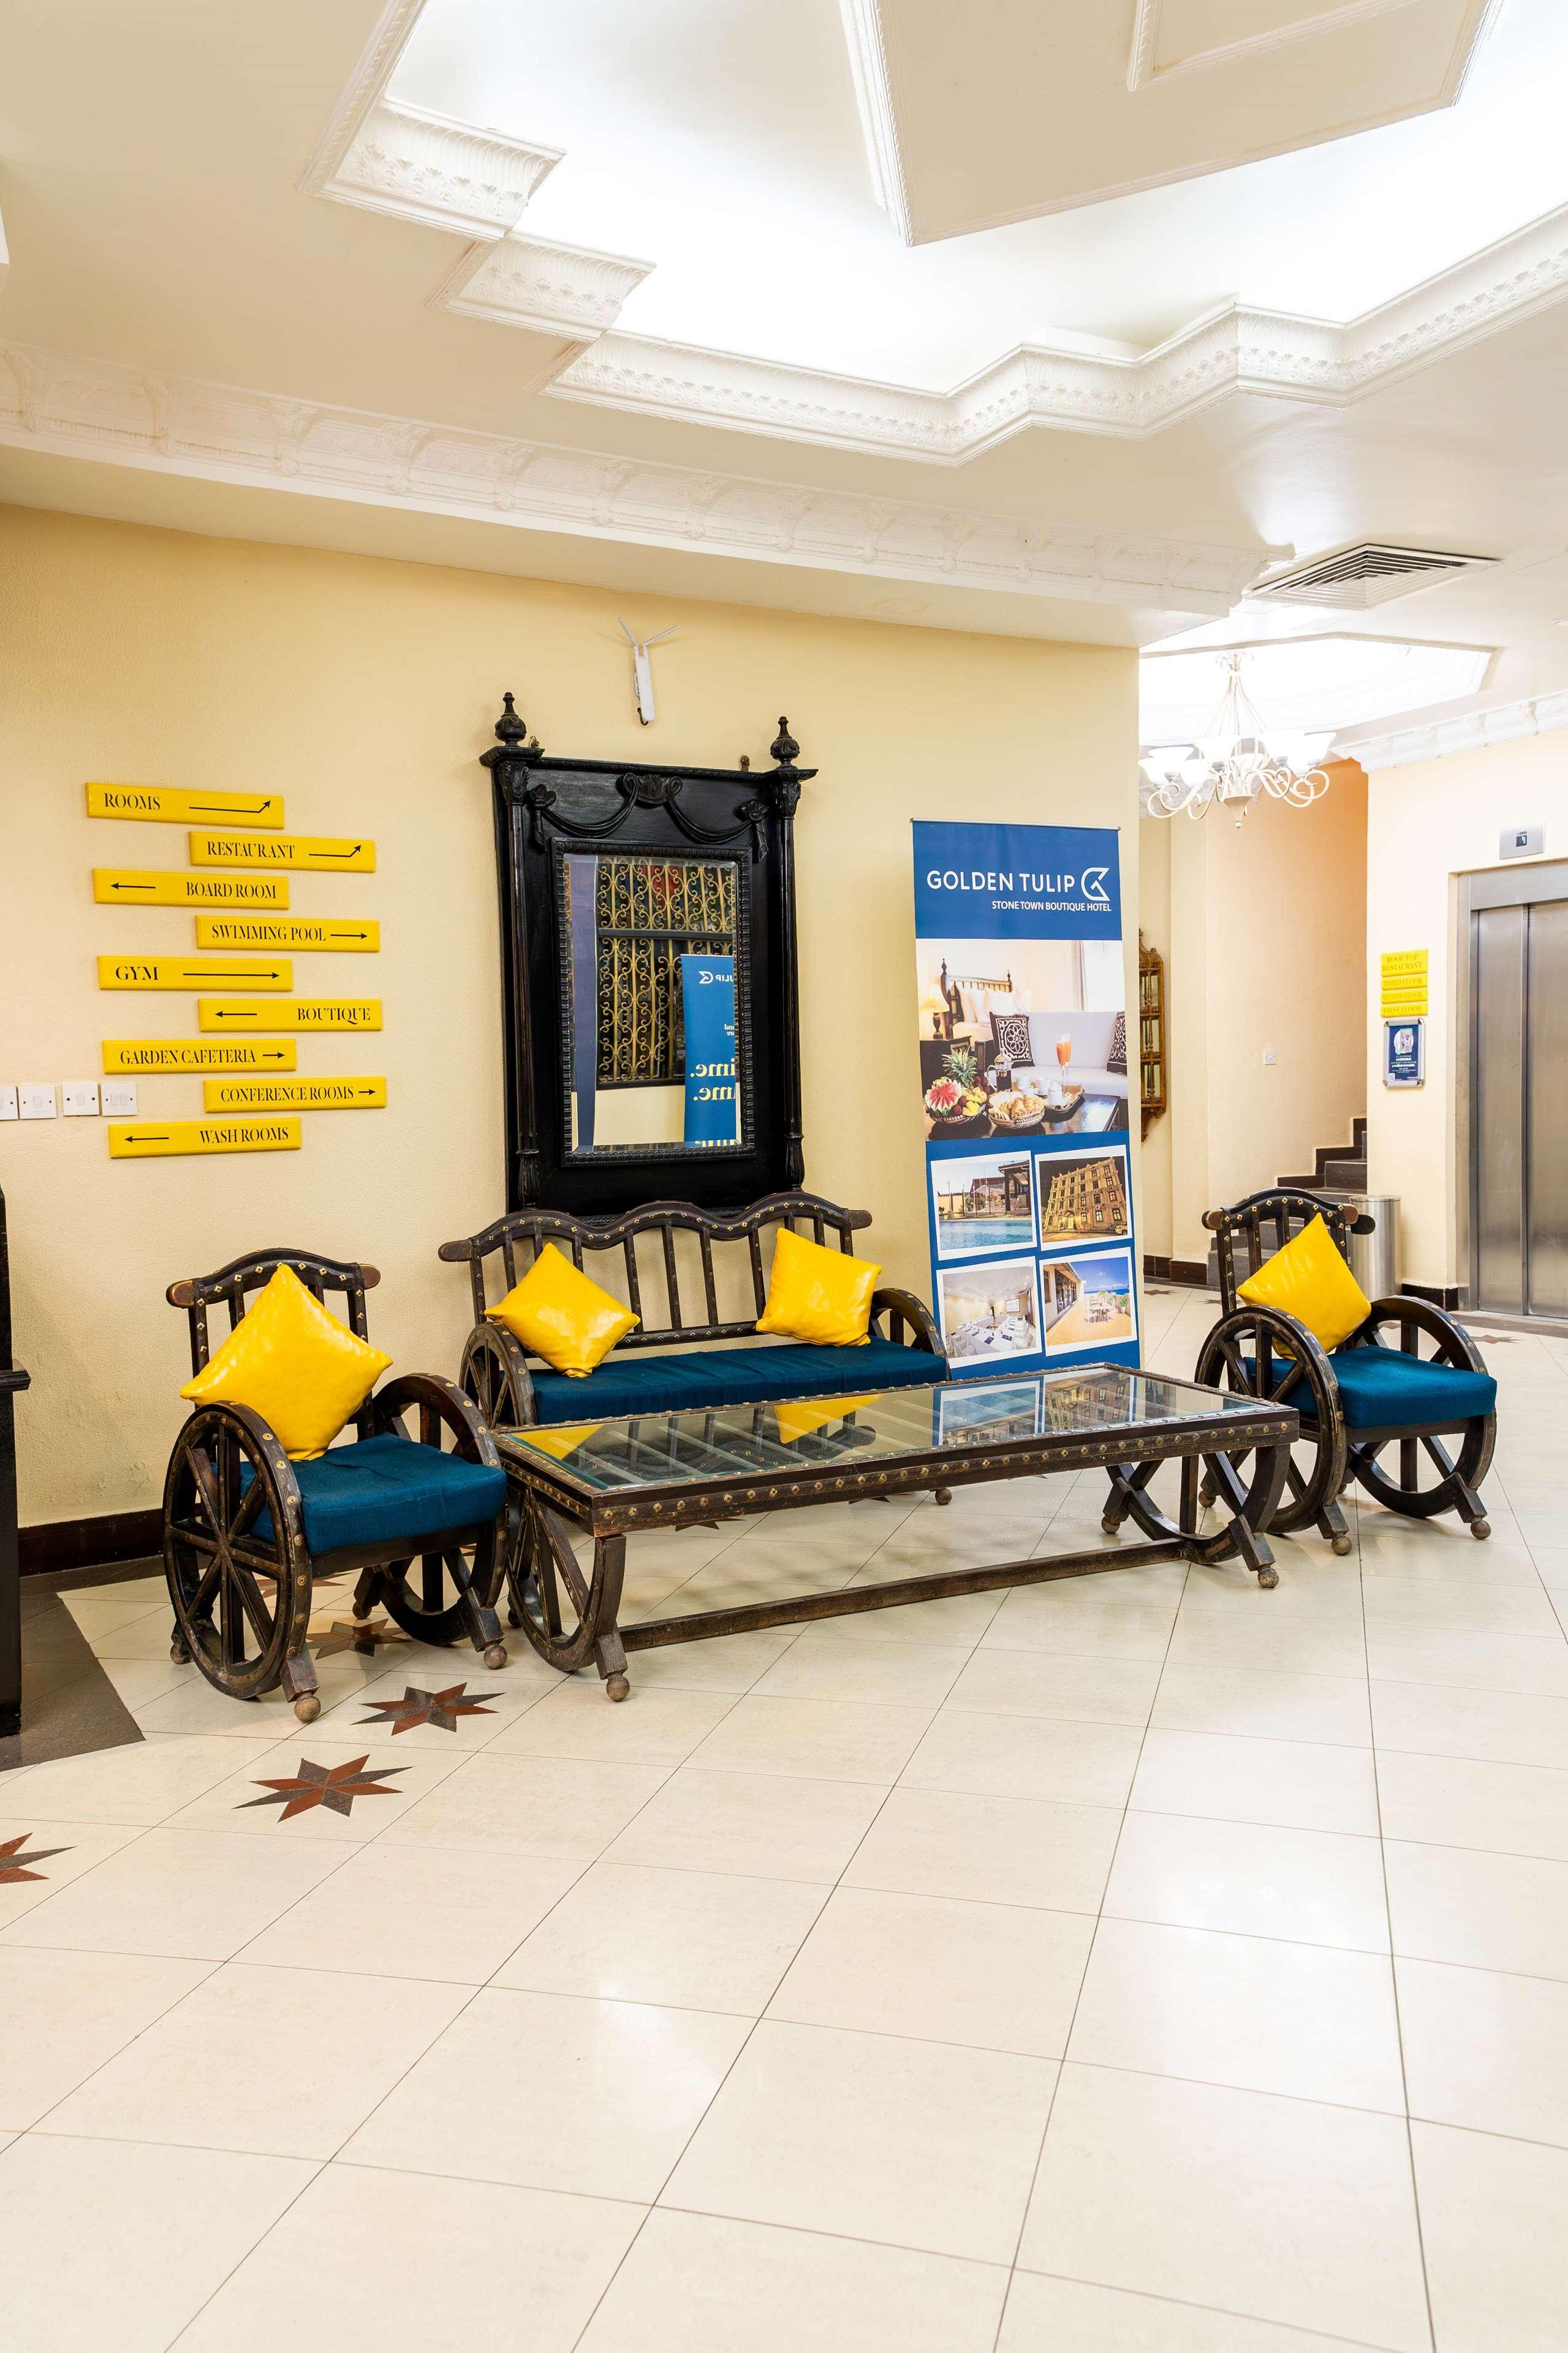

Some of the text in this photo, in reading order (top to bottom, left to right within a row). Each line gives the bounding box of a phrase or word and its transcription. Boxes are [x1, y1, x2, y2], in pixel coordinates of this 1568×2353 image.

[104, 793, 161, 810] ROOMS
[207, 841, 295, 859] RESTAURANT
[926, 870, 1075, 893] GOLDEN TULIP
[186, 882, 276, 899] BOARD ROOM
[992, 900, 1020, 910] STONE
[1020, 901, 1044, 911] TOWN
[1045, 902, 1086, 912] BOUTIQUE
[212, 925, 326, 941] SWIMMING POOL
[115, 966, 158, 981] GYM
[1382, 962, 1423, 971] RESTAURANT
[297, 1008, 371, 1025] BOUTIQUE
[119, 1049, 256, 1064] GARDEN CAFETERIA
[221, 1086, 354, 1101] CONFERENCE ROOMS
[199, 1127, 289, 1144] WASH ROOMS
